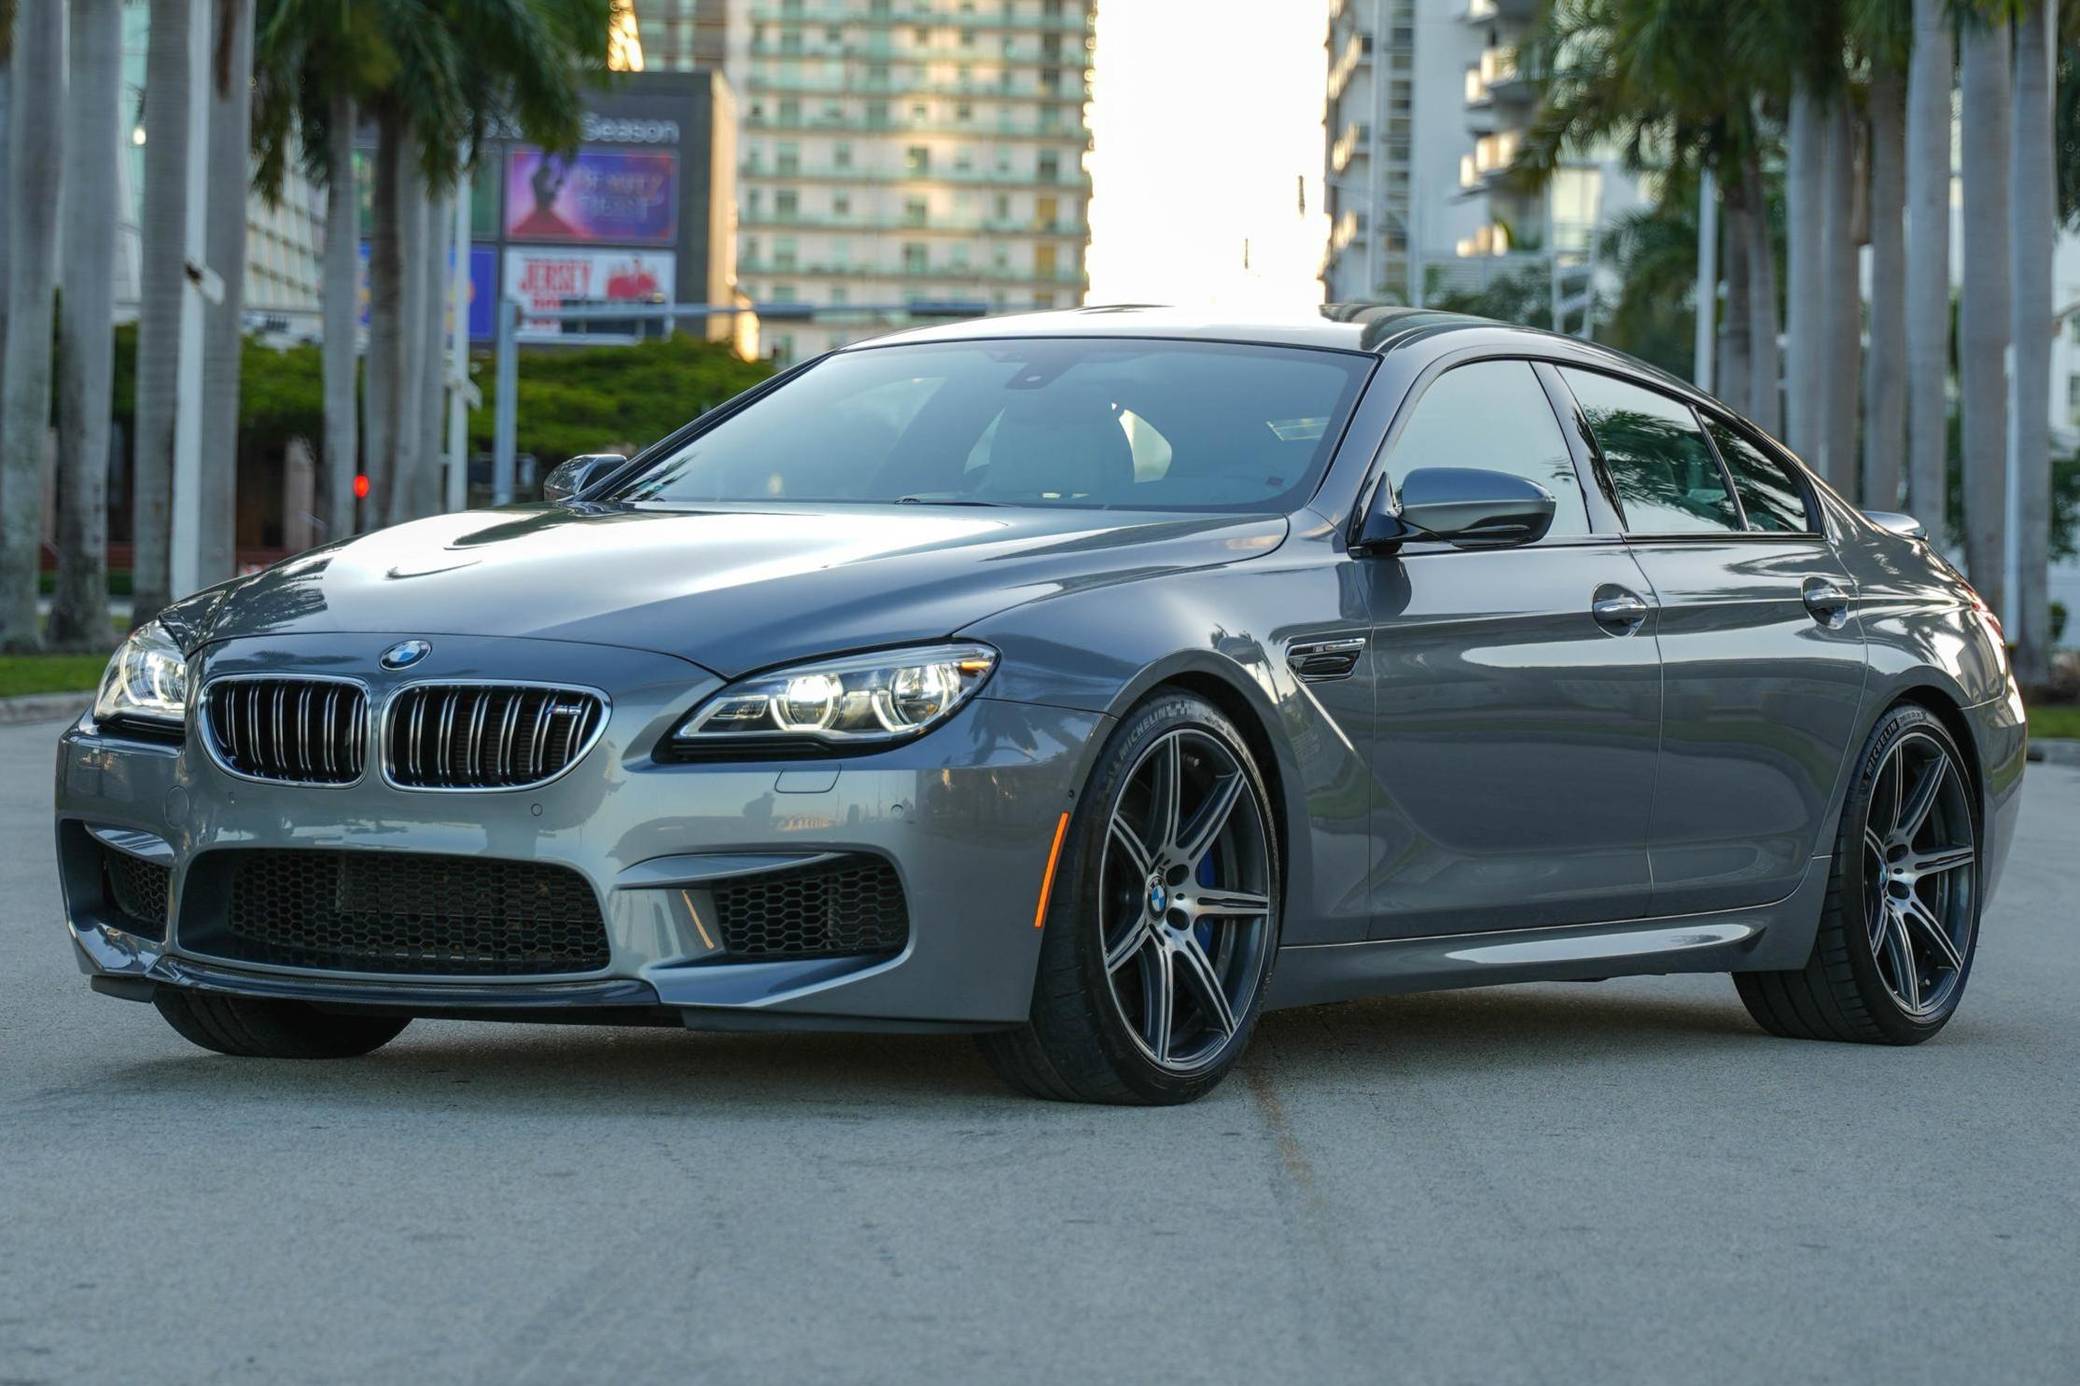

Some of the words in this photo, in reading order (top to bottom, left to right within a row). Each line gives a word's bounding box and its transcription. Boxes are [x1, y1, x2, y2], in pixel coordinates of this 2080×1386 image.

[580, 113, 680, 143] Season
[519, 258, 593, 293] JERSEY
[1119, 705, 1166, 760] MICHELIN
[1865, 720, 1899, 777] MICHELIN
